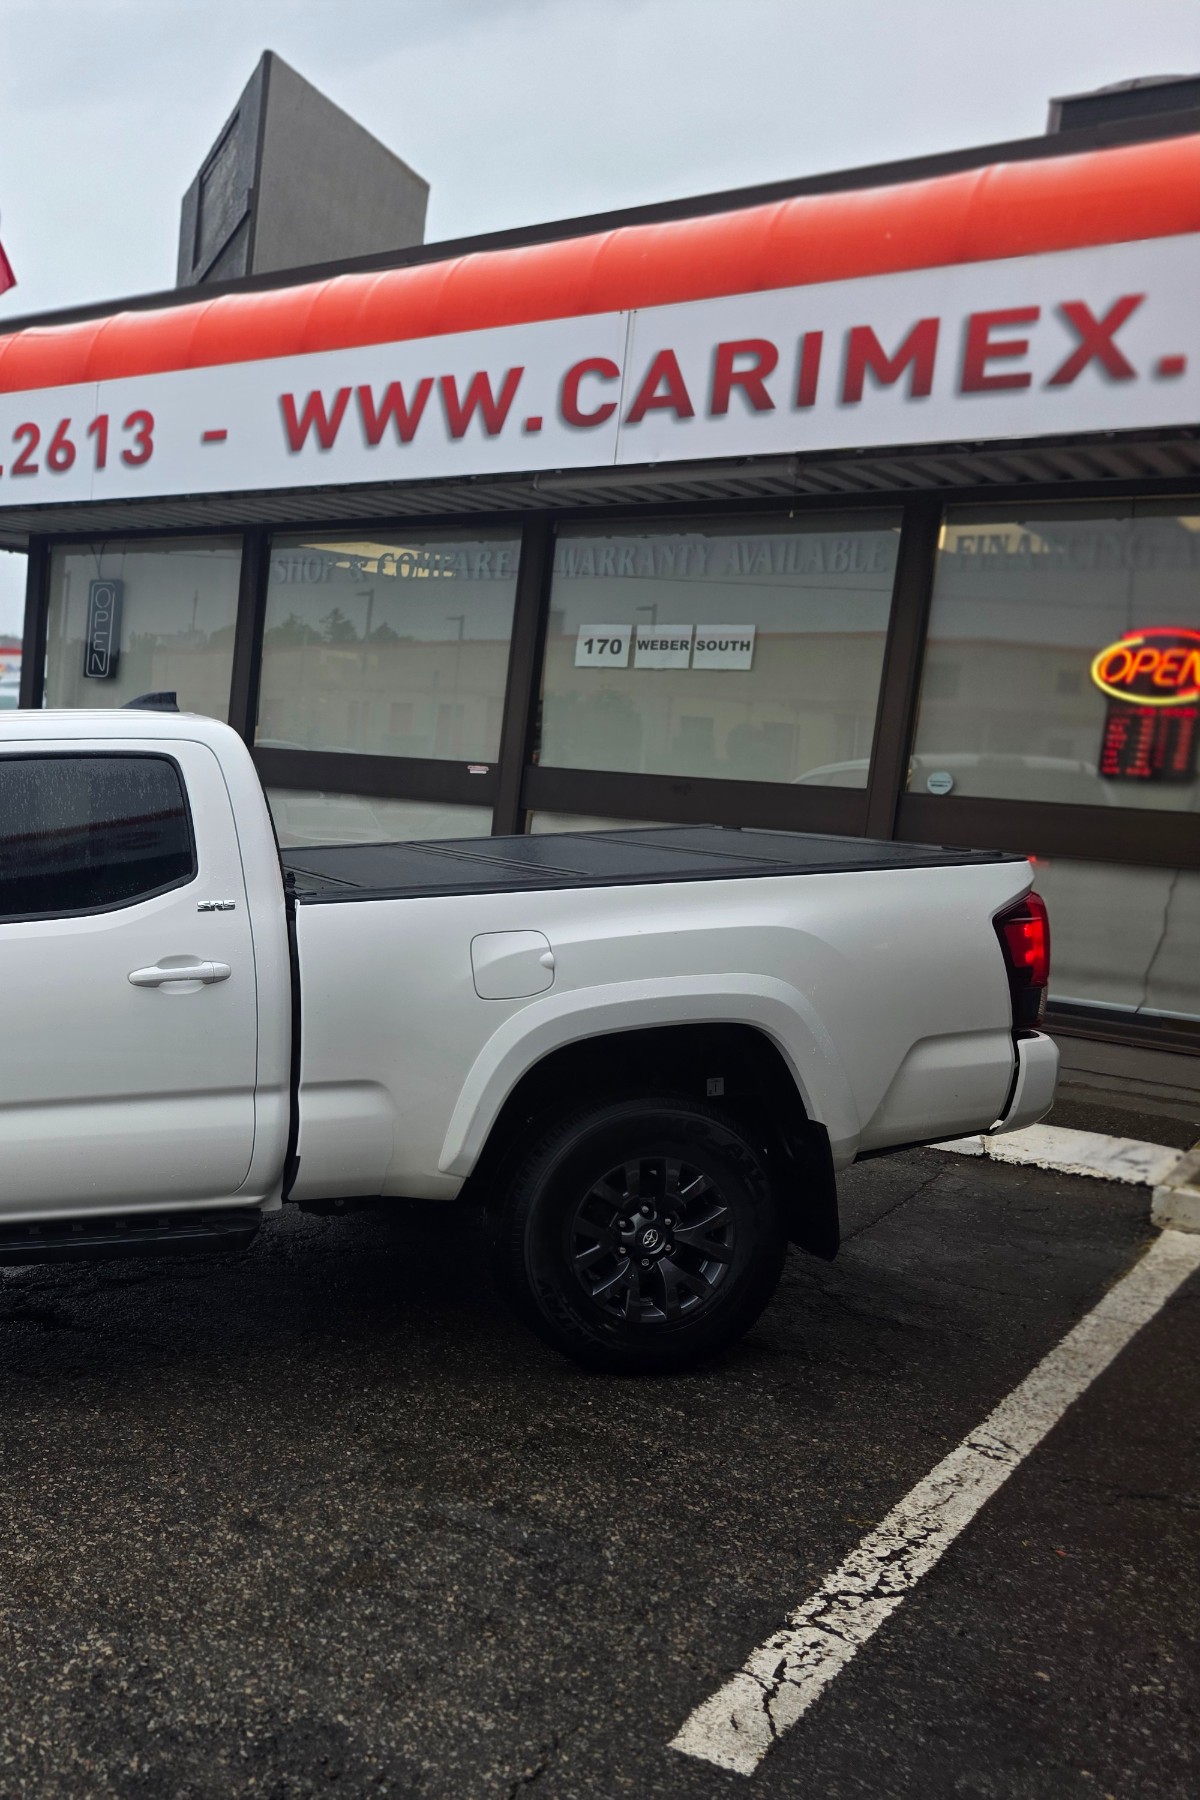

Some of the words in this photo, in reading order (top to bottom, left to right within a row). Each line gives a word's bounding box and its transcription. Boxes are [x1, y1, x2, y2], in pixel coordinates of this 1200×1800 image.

[273, 553, 340, 585] SHOP
[349, 553, 368, 584] &
[375, 550, 516, 583] COMPARE
[557, 542, 713, 579] WARRANTY
[726, 538, 894, 577] AVAILABLE
[90, 586, 113, 675] OPEN
[583, 638, 623, 655] 170
[637, 639, 690, 651] WEBER
[696, 640, 751, 652] SOUTH
[1100, 647, 1200, 688] OPEN
[197, 899, 236, 912] SR5
